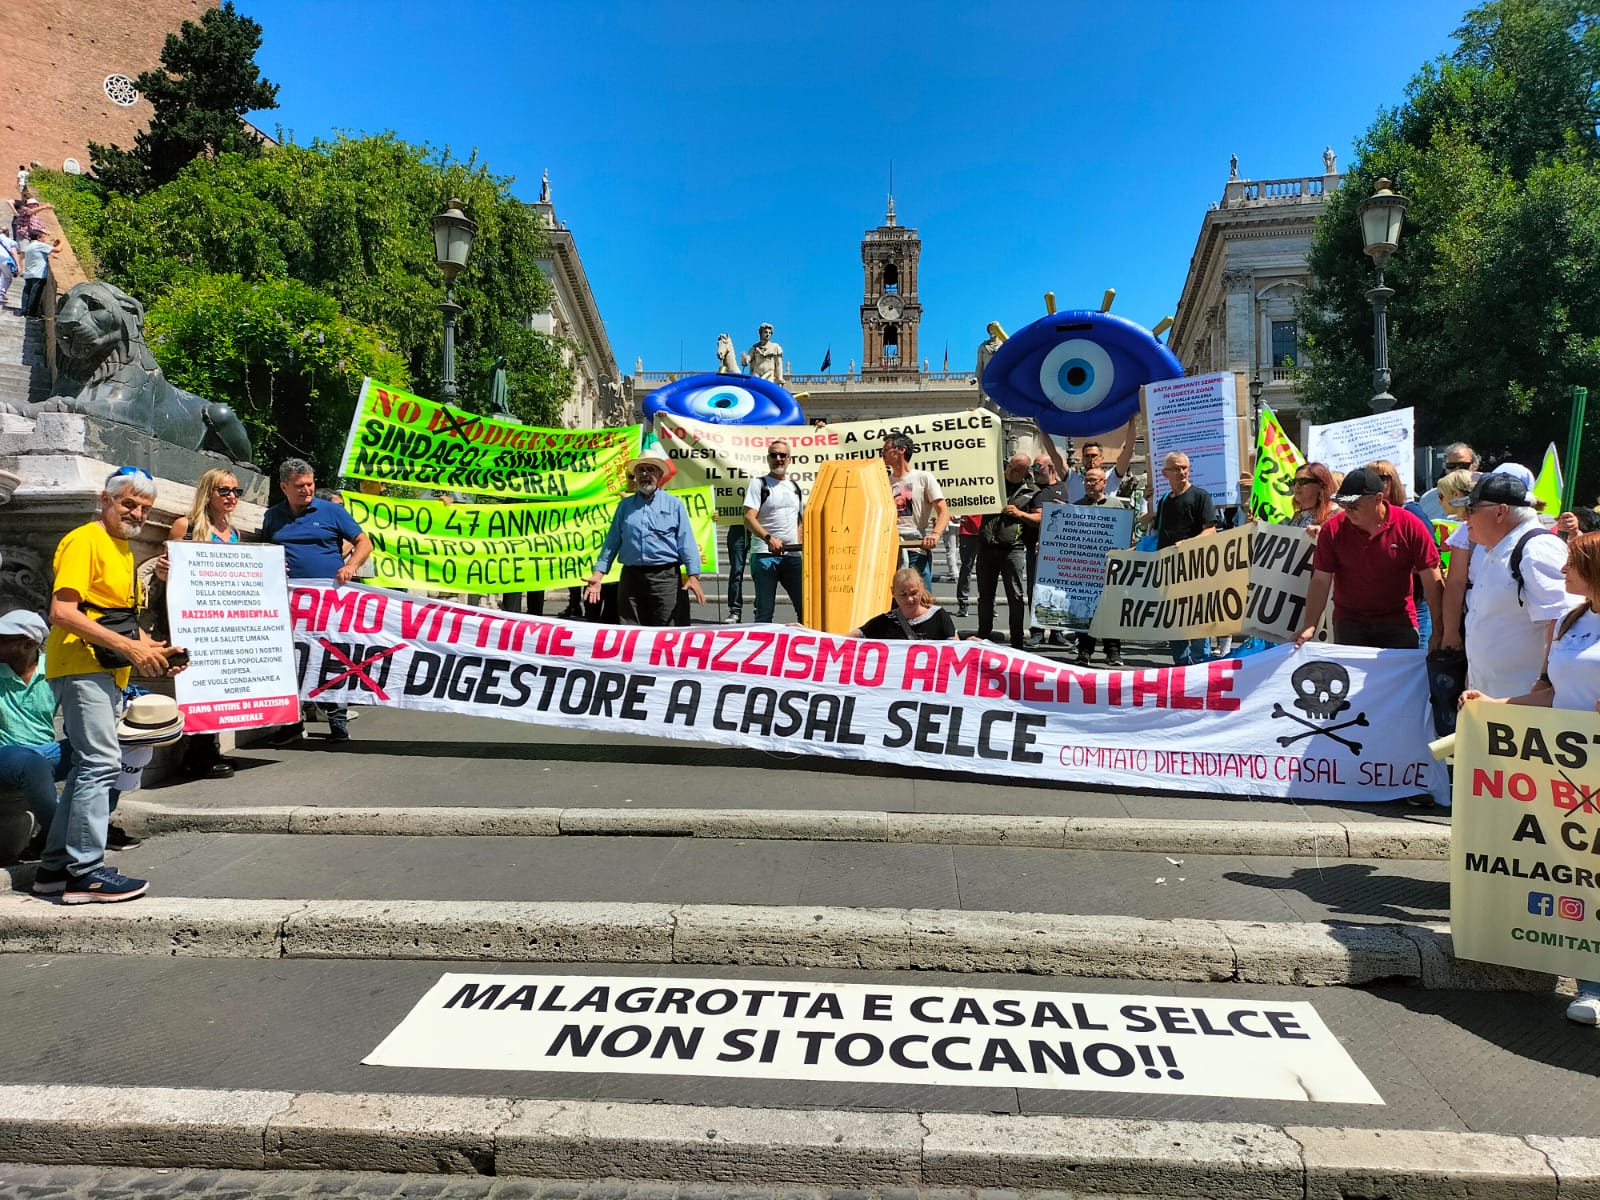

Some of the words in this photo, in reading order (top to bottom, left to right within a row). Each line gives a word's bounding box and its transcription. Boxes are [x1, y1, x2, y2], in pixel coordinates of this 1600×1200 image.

[371, 388, 421, 423] NO
[661, 427, 686, 440] NO
[845, 432, 857, 443] A
[933, 416, 992, 432] SELCE
[735, 453, 809, 464] IMPITO
[835, 448, 883, 460] RIFIUT
[913, 438, 986, 453] STRUGGE
[353, 447, 415, 481] NON
[447, 467, 568, 497] RIUSCIRAI
[706, 468, 720, 479] IL
[936, 476, 994, 488] MPIANTO
[946, 494, 995, 507] asalselce
[349, 498, 432, 534] DOPO
[445, 510, 480, 536] 47
[396, 535, 476, 556] ALTRO
[482, 529, 585, 555] IMPIANTO
[1078, 543, 1097, 551] ROMA
[216, 561, 263, 569] DEMOCRATICO
[424, 559, 457, 584] LO
[467, 555, 593, 585] ACCETTIAM
[1107, 544, 1219, 588] RIFIUTIAMO
[182, 610, 224, 619] RAZZISMO
[227, 609, 279, 618] AMBIENTALE
[1120, 587, 1243, 629] RIFIUTIAMO
[190, 659, 221, 667] ERRITORI
[238, 656, 282, 665] POPOLAZIONE
[289, 587, 388, 634] AMO
[401, 598, 576, 658] VITTIME
[591, 629, 637, 663] DI
[649, 630, 889, 687] RAZZISMO
[901, 644, 1243, 711] AMBIENTALE
[221, 667, 250, 675] INDIFESA
[230, 676, 273, 684] CONDANNARE
[224, 686, 250, 694] MORIRE
[318, 642, 393, 692] BIO
[404, 650, 656, 721] DIGESTORE
[663, 679, 702, 727] A
[713, 684, 865, 745] CASAL
[883, 700, 1047, 764] SELCE
[188, 704, 211, 714] SIAMO
[213, 702, 240, 712] VITTIME
[243, 701, 252, 709] DI
[253, 698, 289, 708] RAZZISMO
[219, 713, 263, 724] AMBIENTALE
[1486, 721, 1600, 769] BAS
[1060, 745, 1148, 772] COMITATO
[1155, 751, 1267, 780] DIFENDIAMO
[1275, 757, 1346, 785] CASAL
[1358, 761, 1430, 789] SELCE
[1472, 768, 1537, 802] NO
[1550, 778, 1600, 815] BI
[1512, 814, 1547, 845] A
[442, 983, 844, 1020] MALAGROTTA
[862, 993, 893, 1021] E
[909, 995, 1108, 1031] CASAL
[1120, 1004, 1311, 1040] SELCE
[545, 1024, 705, 1060] NON
[716, 1027, 780, 1063] SI
[796, 1031, 1186, 1081] TOCCANO!!
